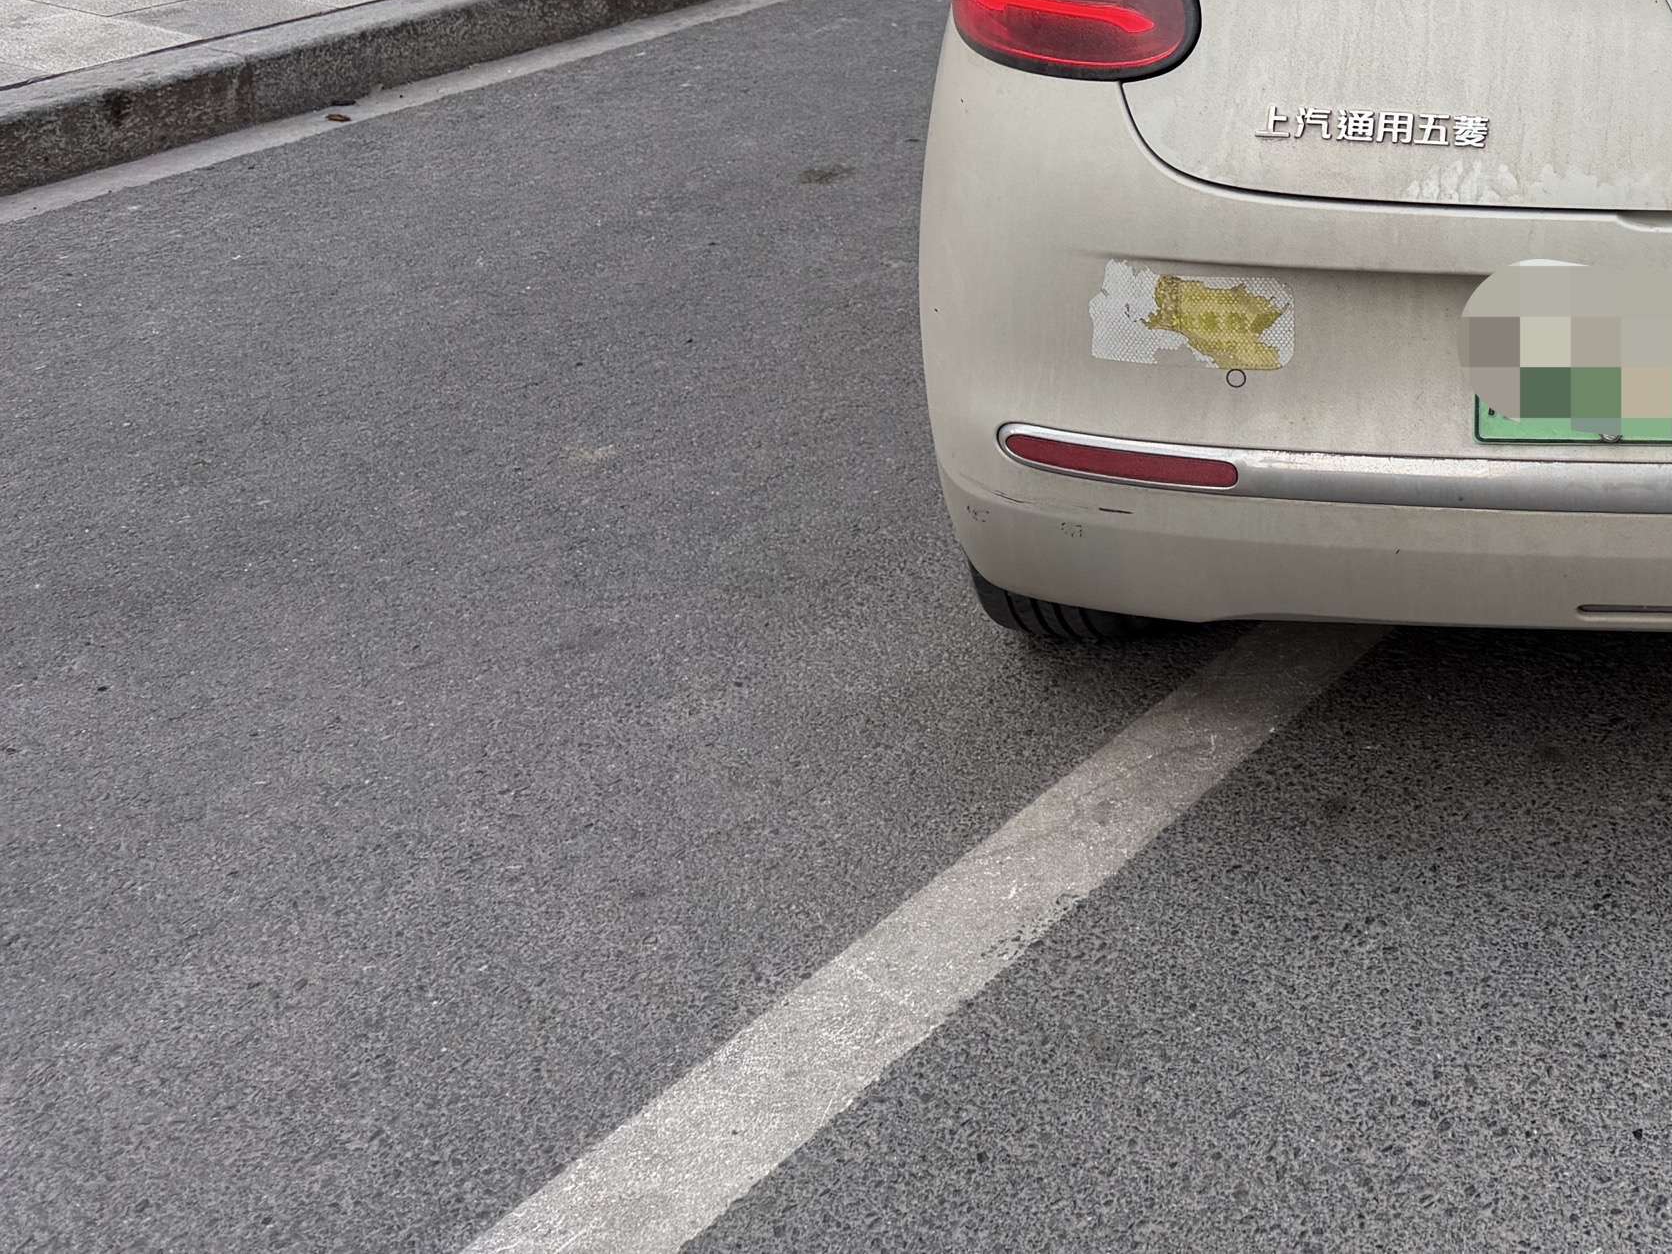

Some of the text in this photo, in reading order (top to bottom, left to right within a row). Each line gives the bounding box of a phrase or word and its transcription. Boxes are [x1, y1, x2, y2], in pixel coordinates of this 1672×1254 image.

[1254, 106, 1489, 148] 上汽通用五菱
